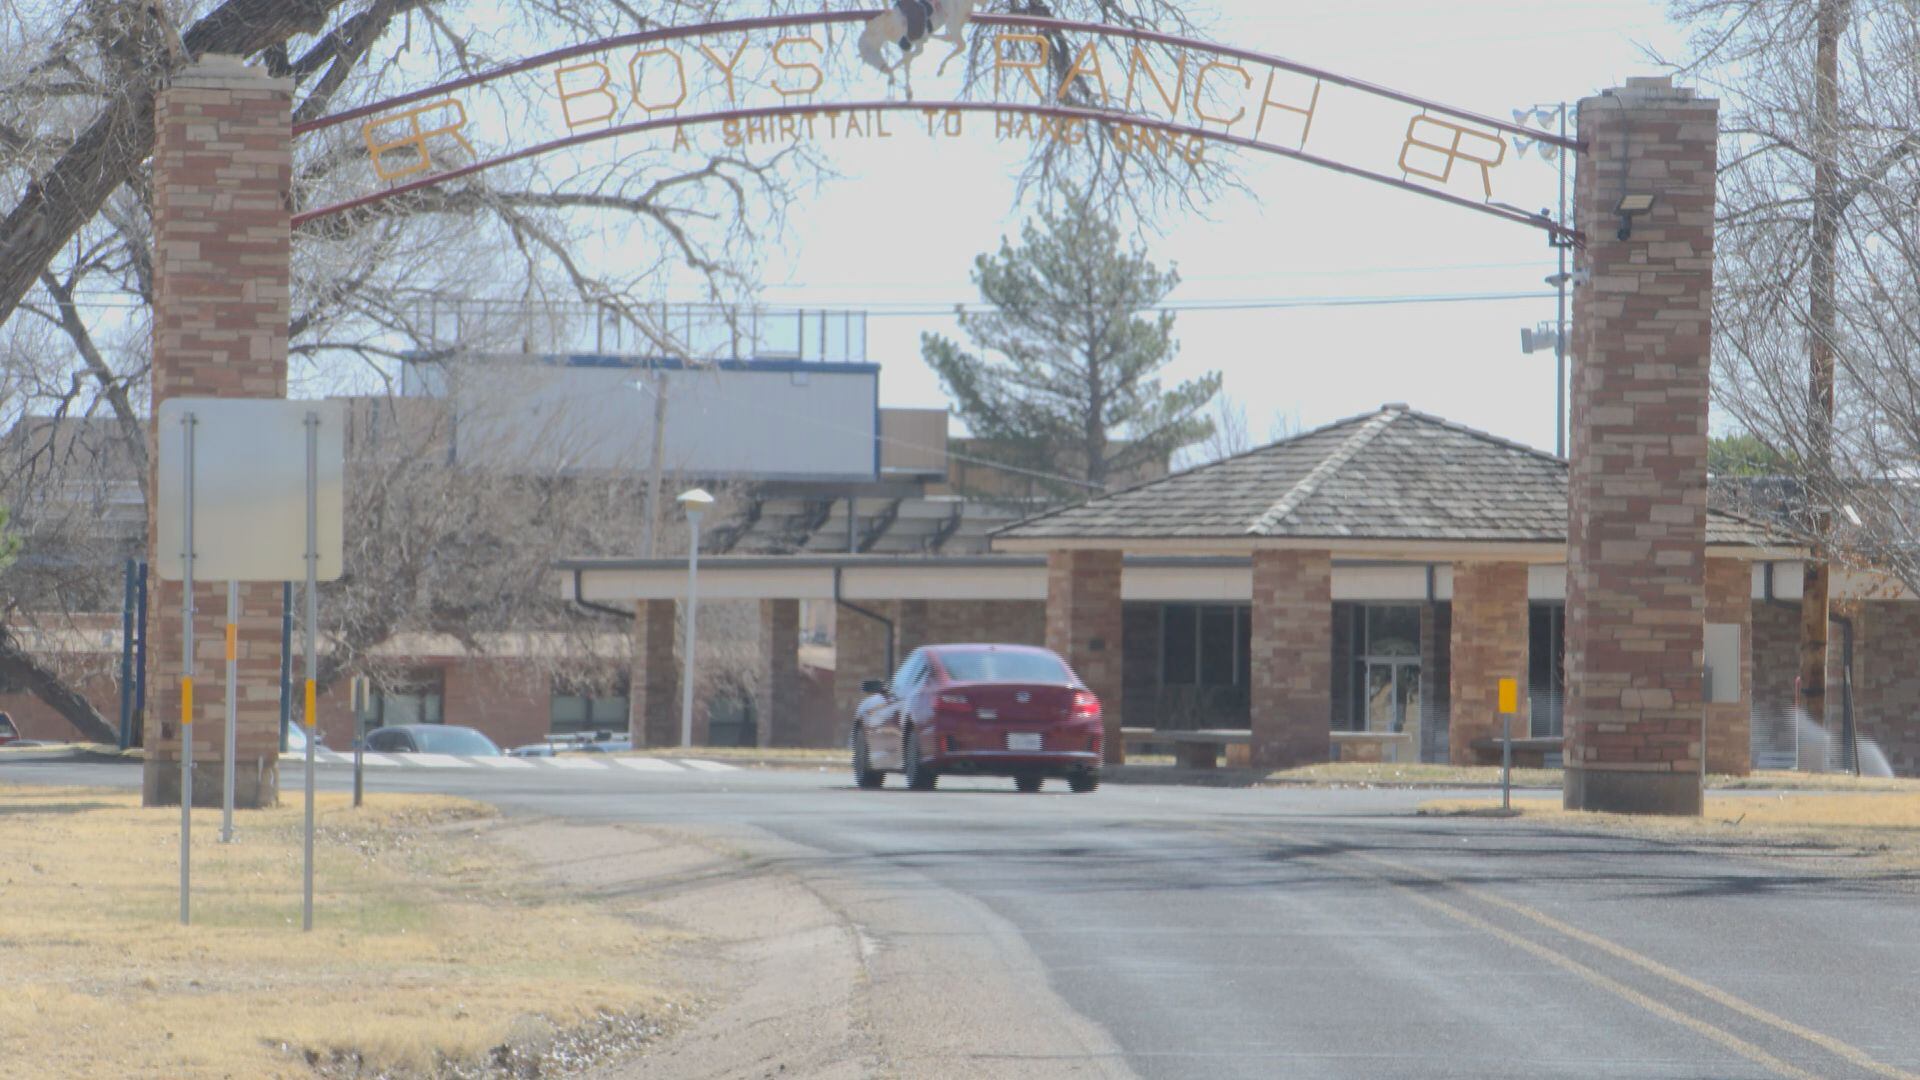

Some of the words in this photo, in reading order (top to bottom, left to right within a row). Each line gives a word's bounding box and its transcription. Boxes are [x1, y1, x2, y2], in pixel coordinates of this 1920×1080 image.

[554, 36, 824, 128] BOYS
[993, 33, 1321, 148] RANCH
[673, 124, 691, 152] A
[922, 108, 962, 137] TO
[995, 109, 1085, 145] HANG
[1113, 122, 1205, 165] ONTO
